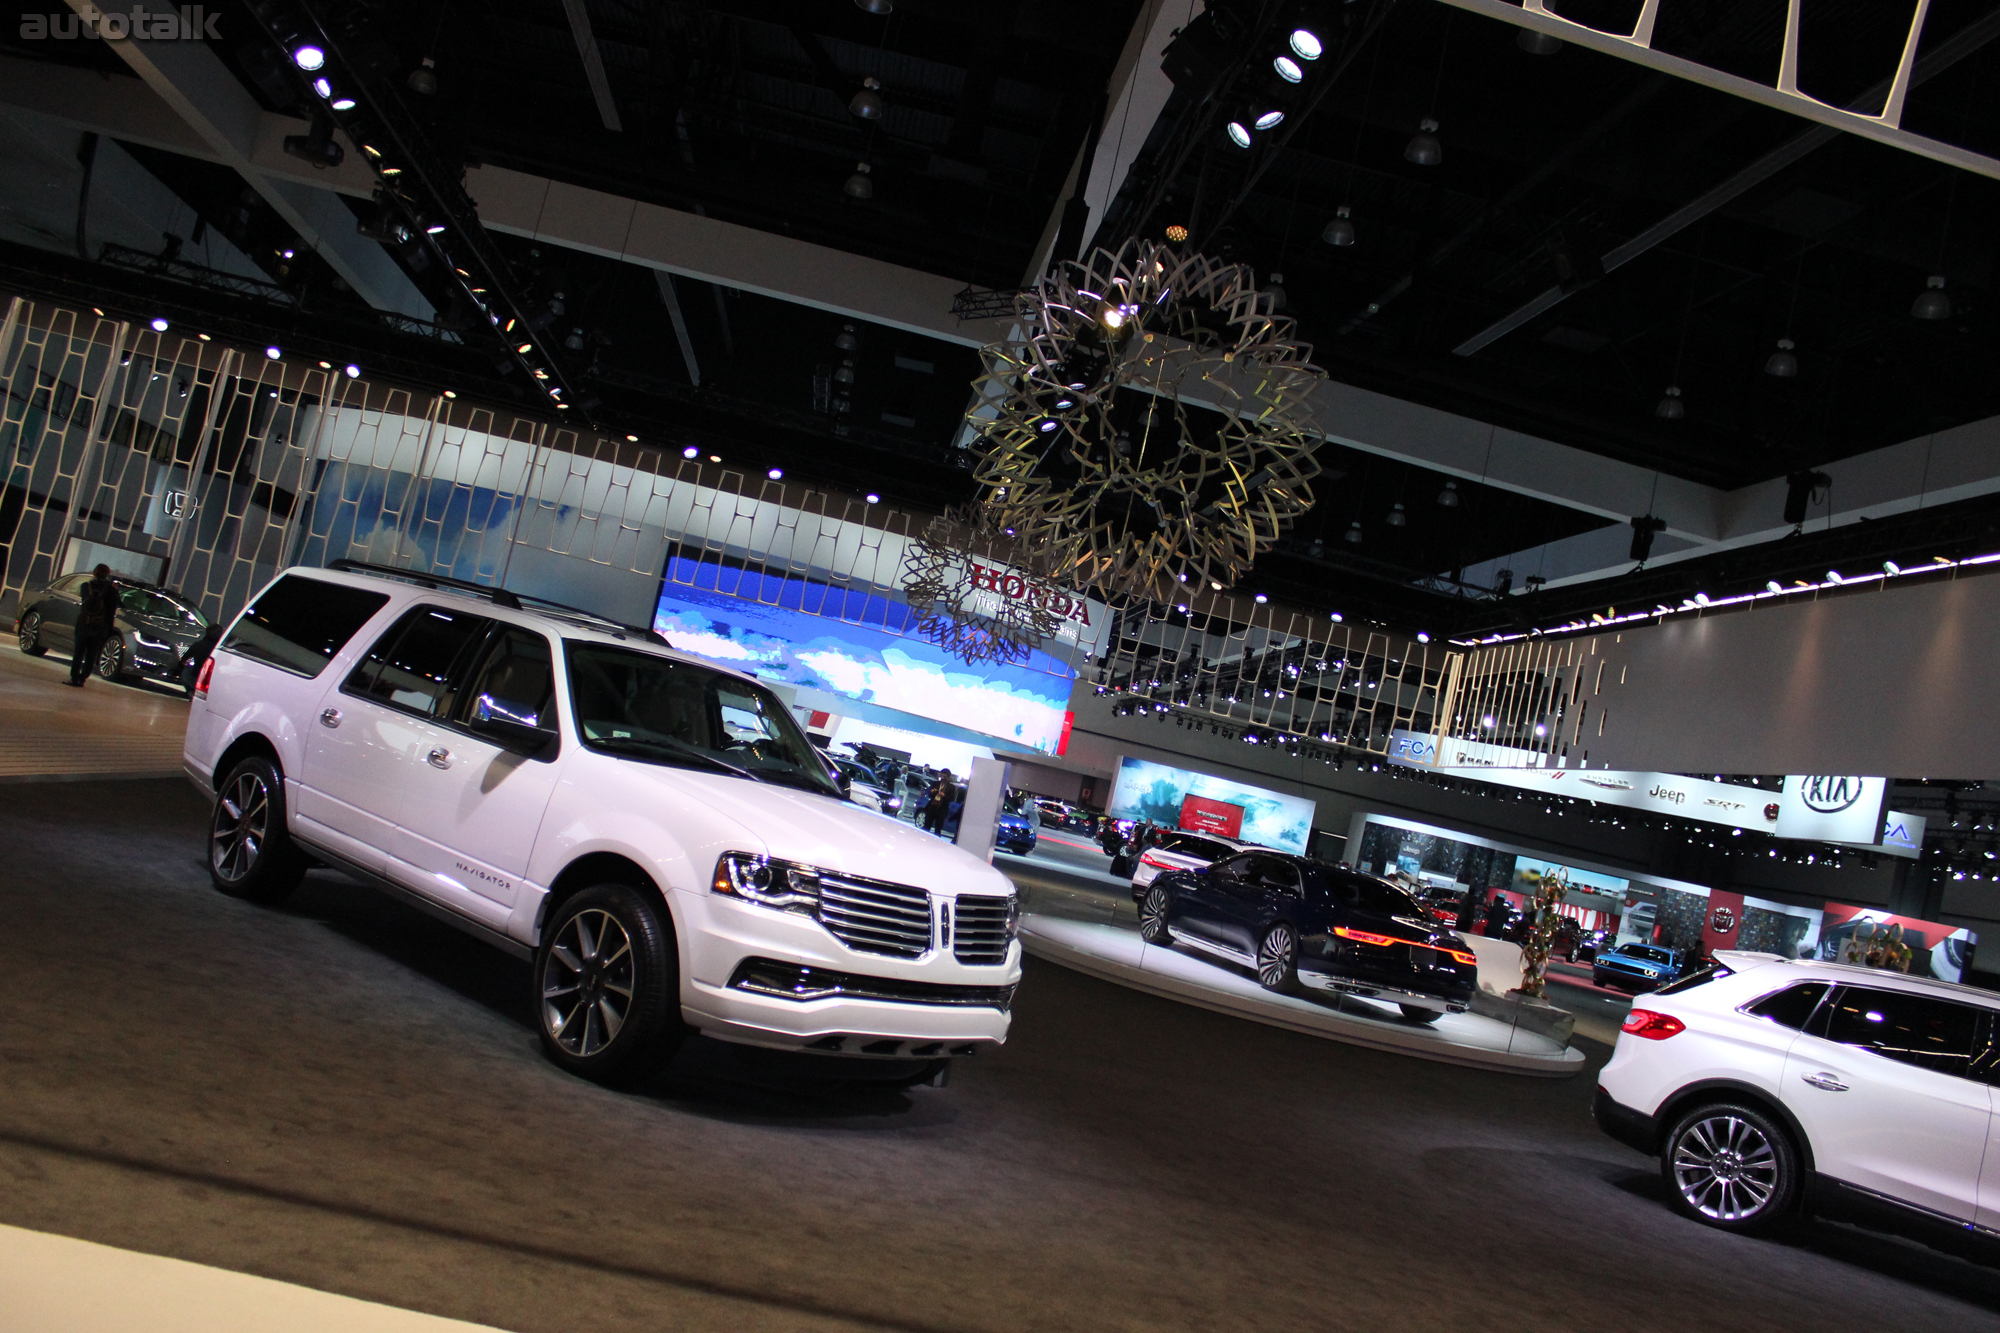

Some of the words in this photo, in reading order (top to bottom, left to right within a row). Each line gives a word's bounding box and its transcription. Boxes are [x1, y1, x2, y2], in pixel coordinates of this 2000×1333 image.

[968, 563, 1091, 626] HONDA
[976, 594, 998, 611] The
[1399, 738, 1435, 757] FCA
[1124, 779, 1153, 795] Jeep
[1649, 784, 1686, 804] Jeep
[1809, 776, 1848, 803] KIA
[1703, 798, 1746, 811] SRT
[1403, 845, 1421, 856] Jeep
[456, 862, 511, 891] NAVIGATOR
